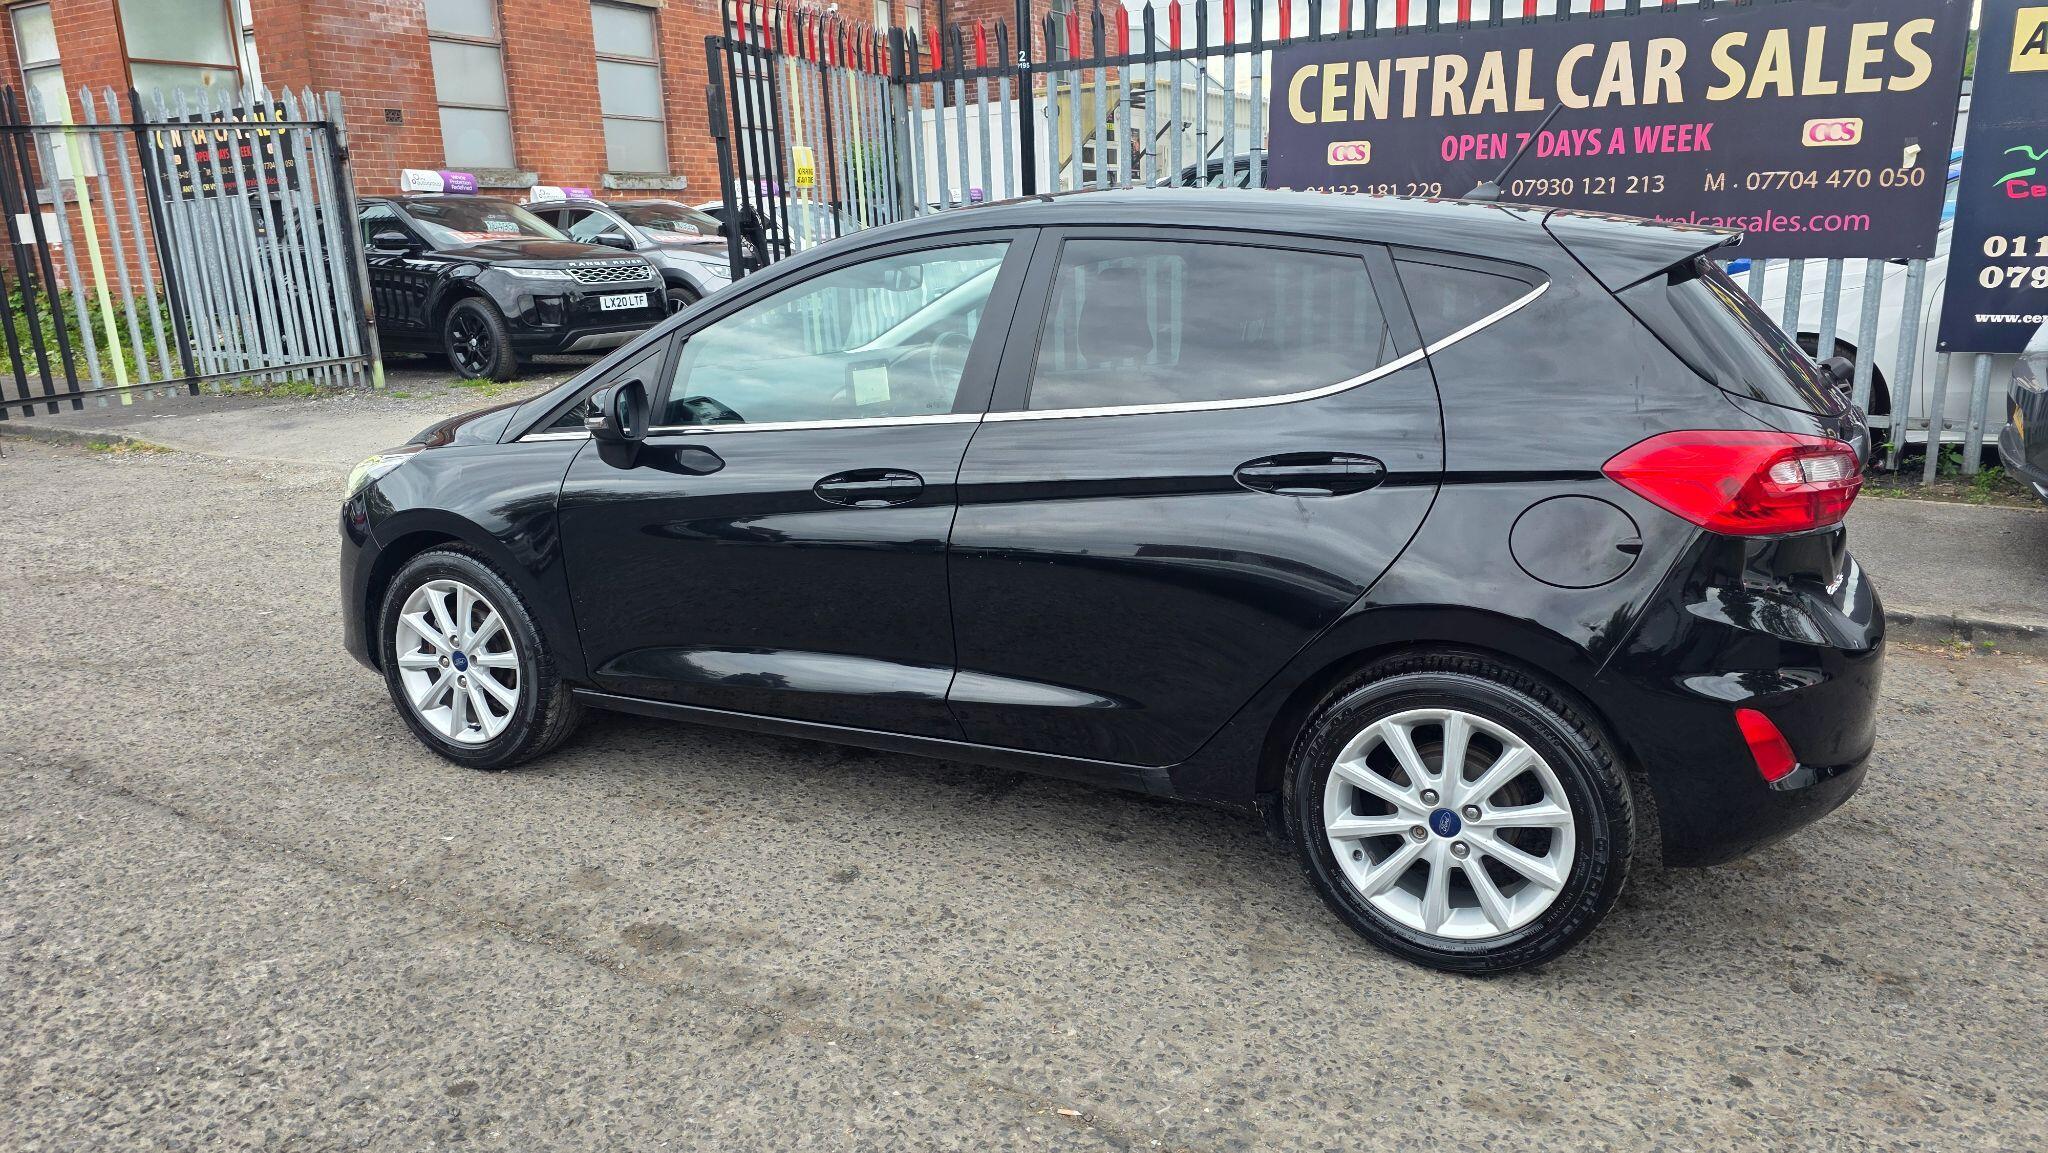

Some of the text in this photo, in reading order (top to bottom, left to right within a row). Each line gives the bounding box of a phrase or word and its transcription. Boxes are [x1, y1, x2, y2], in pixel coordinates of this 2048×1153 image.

[1018, 50, 1026, 62] 2
[1288, 17, 1936, 124] CENTRAL CAR SALES
[1441, 132, 1508, 162] OPEN
[1536, 128, 1602, 158] DAYS
[1607, 127, 1626, 155] A
[1633, 122, 1714, 154] WEEK
[1808, 121, 1856, 143] CCS
[1332, 144, 1366, 162] CCS
[1407, 182, 1442, 199] 229
[1511, 178, 1574, 197] 07930
[1582, 176, 1616, 195] 121
[1625, 174, 1665, 194] 213
[1746, 170, 1819, 191] 07704
[1825, 168, 1871, 188] 470
[1879, 167, 1926, 188] 050
[1655, 209, 1870, 233] tralcarsales.com
[1979, 265, 2048, 289] 079
[604, 295, 644, 309] LX20 LTF
